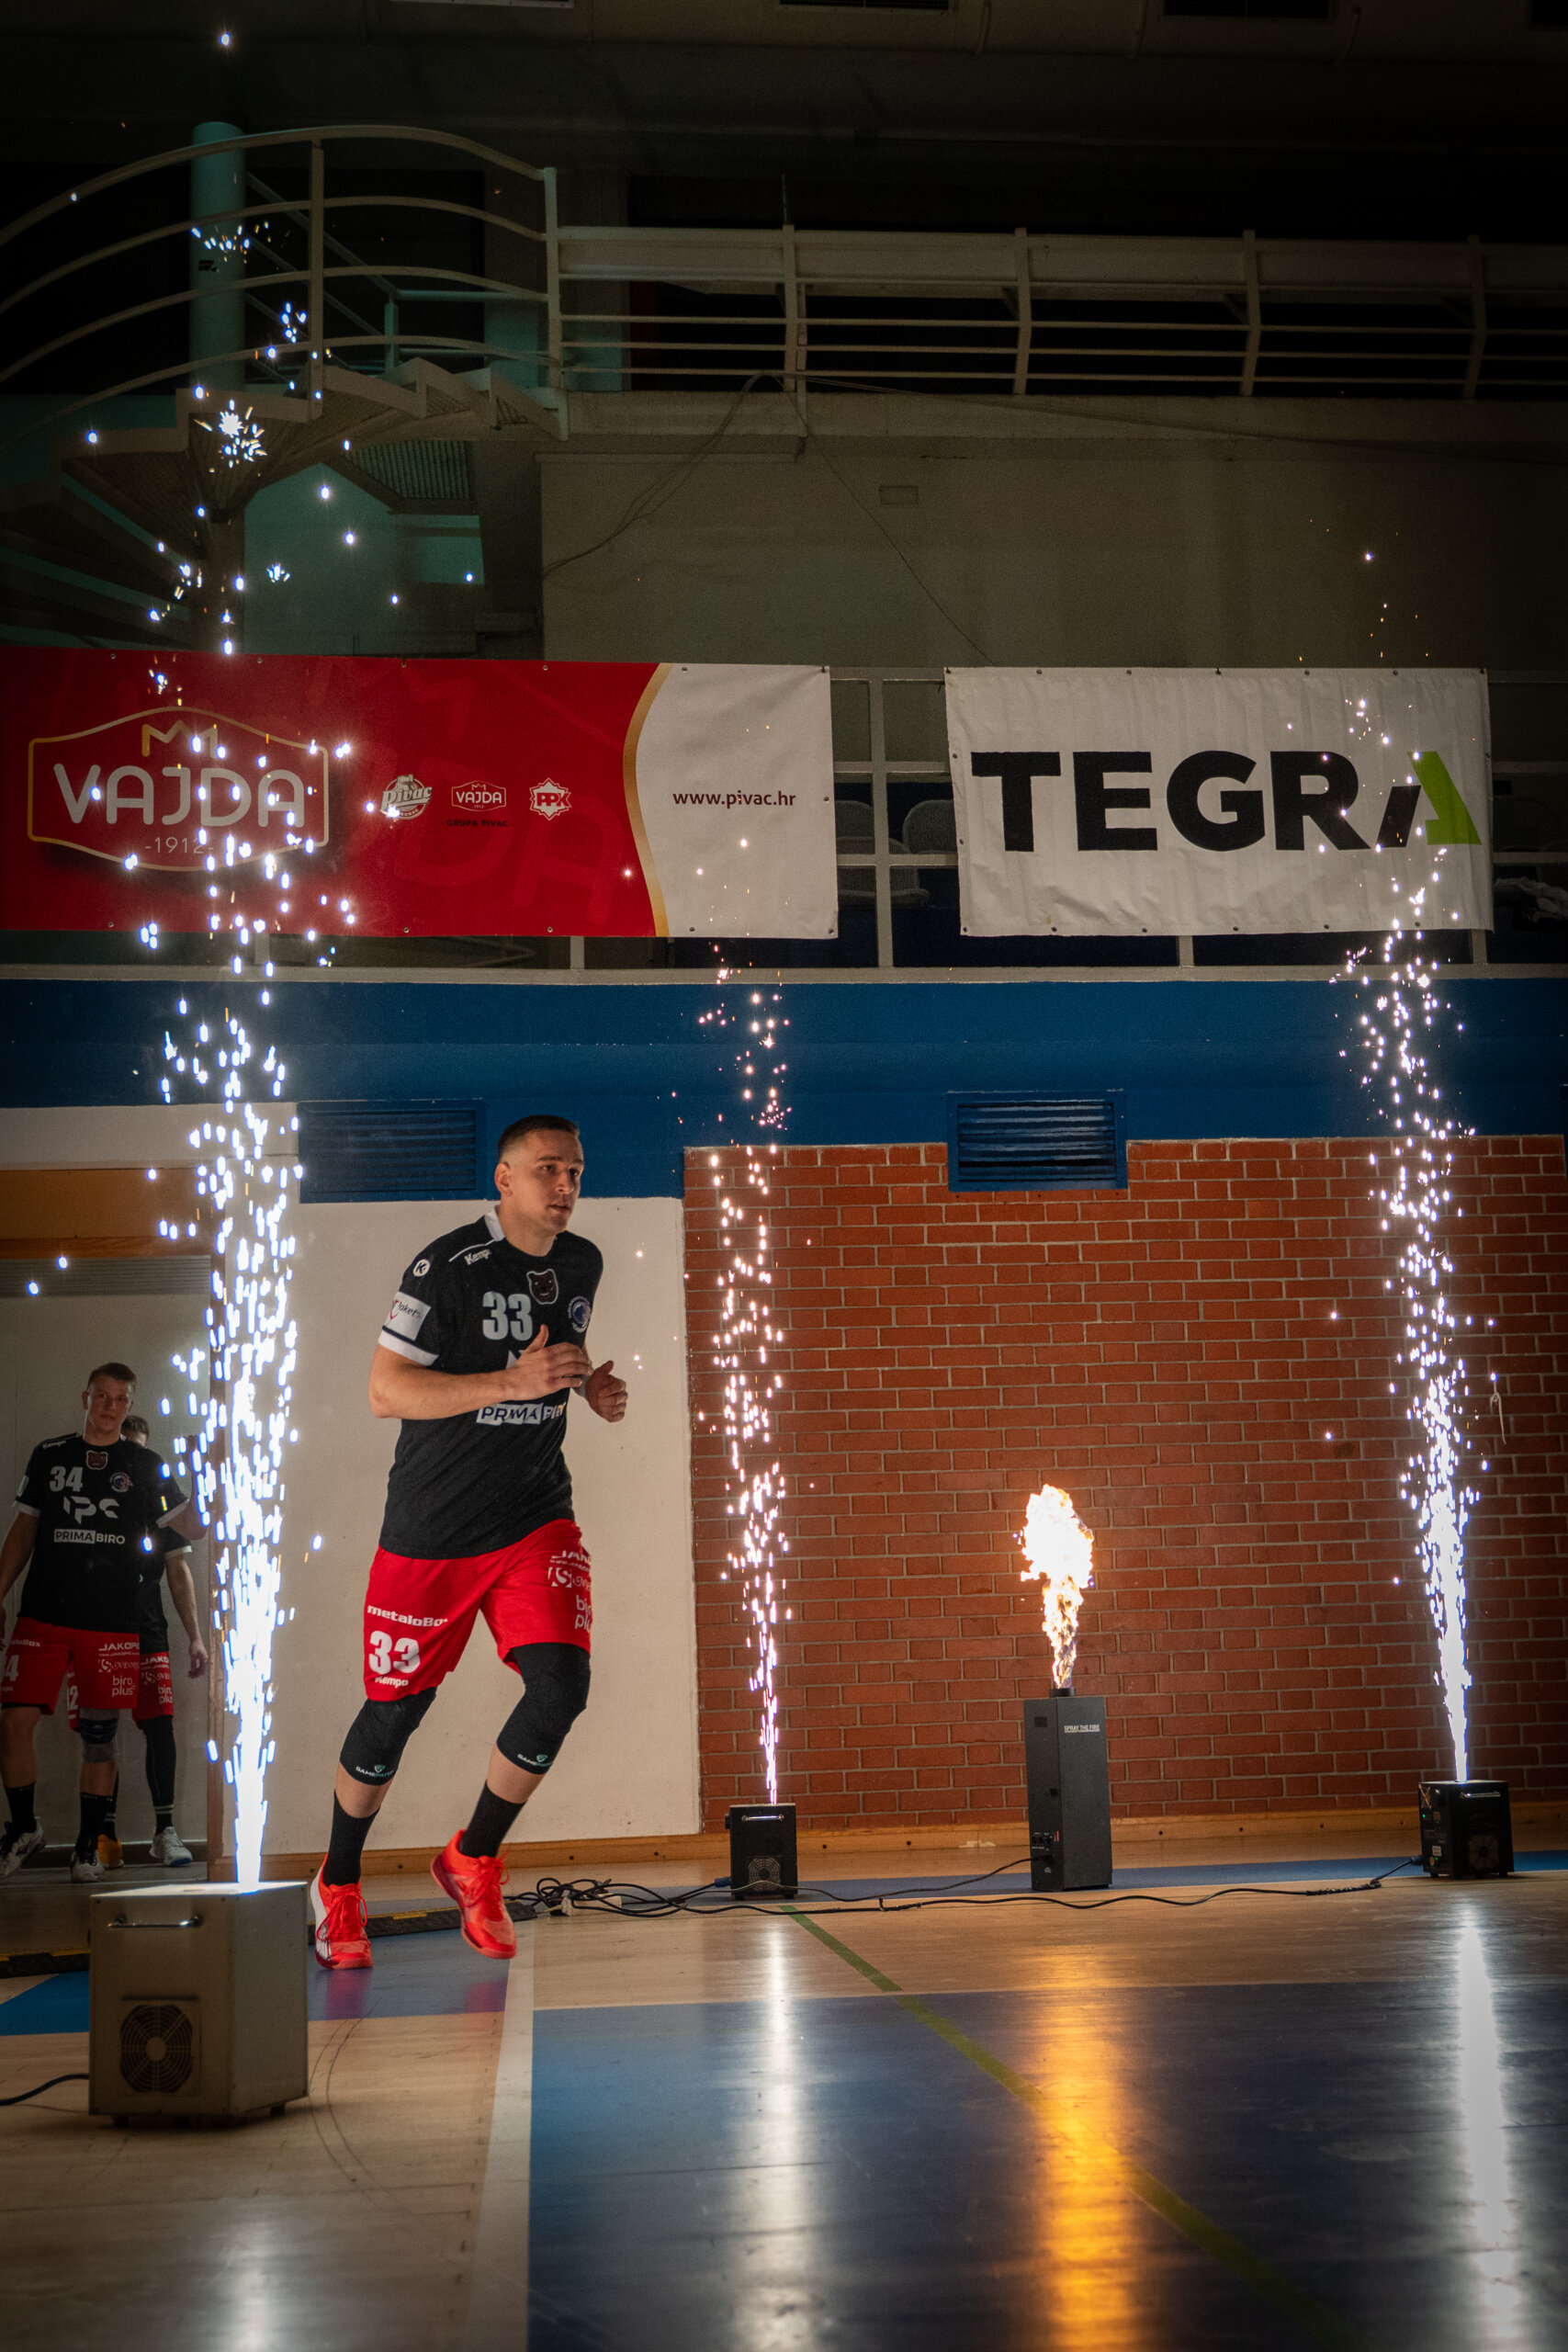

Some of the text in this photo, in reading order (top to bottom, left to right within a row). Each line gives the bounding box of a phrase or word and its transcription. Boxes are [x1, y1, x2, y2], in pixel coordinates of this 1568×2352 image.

[53, 763, 305, 827] VAJDA
[456, 791, 502, 804] VAJDA
[536, 792, 570, 807] PPK
[672, 790, 796, 808] www.pivac.hr
[971, 750, 1482, 853] TEGRA
[446, 819, 479, 827] GRUPA
[464, 1249, 492, 1266] Kemp
[482, 1291, 533, 1341] 33
[50, 1465, 84, 1492] 34
[56, 1531, 126, 1545] PRIMA BIRO
[367, 1605, 448, 1627] metaloBo
[368, 1630, 421, 1675] 33
[112, 1675, 132, 1686] biro
[112, 1686, 133, 1698] plus
